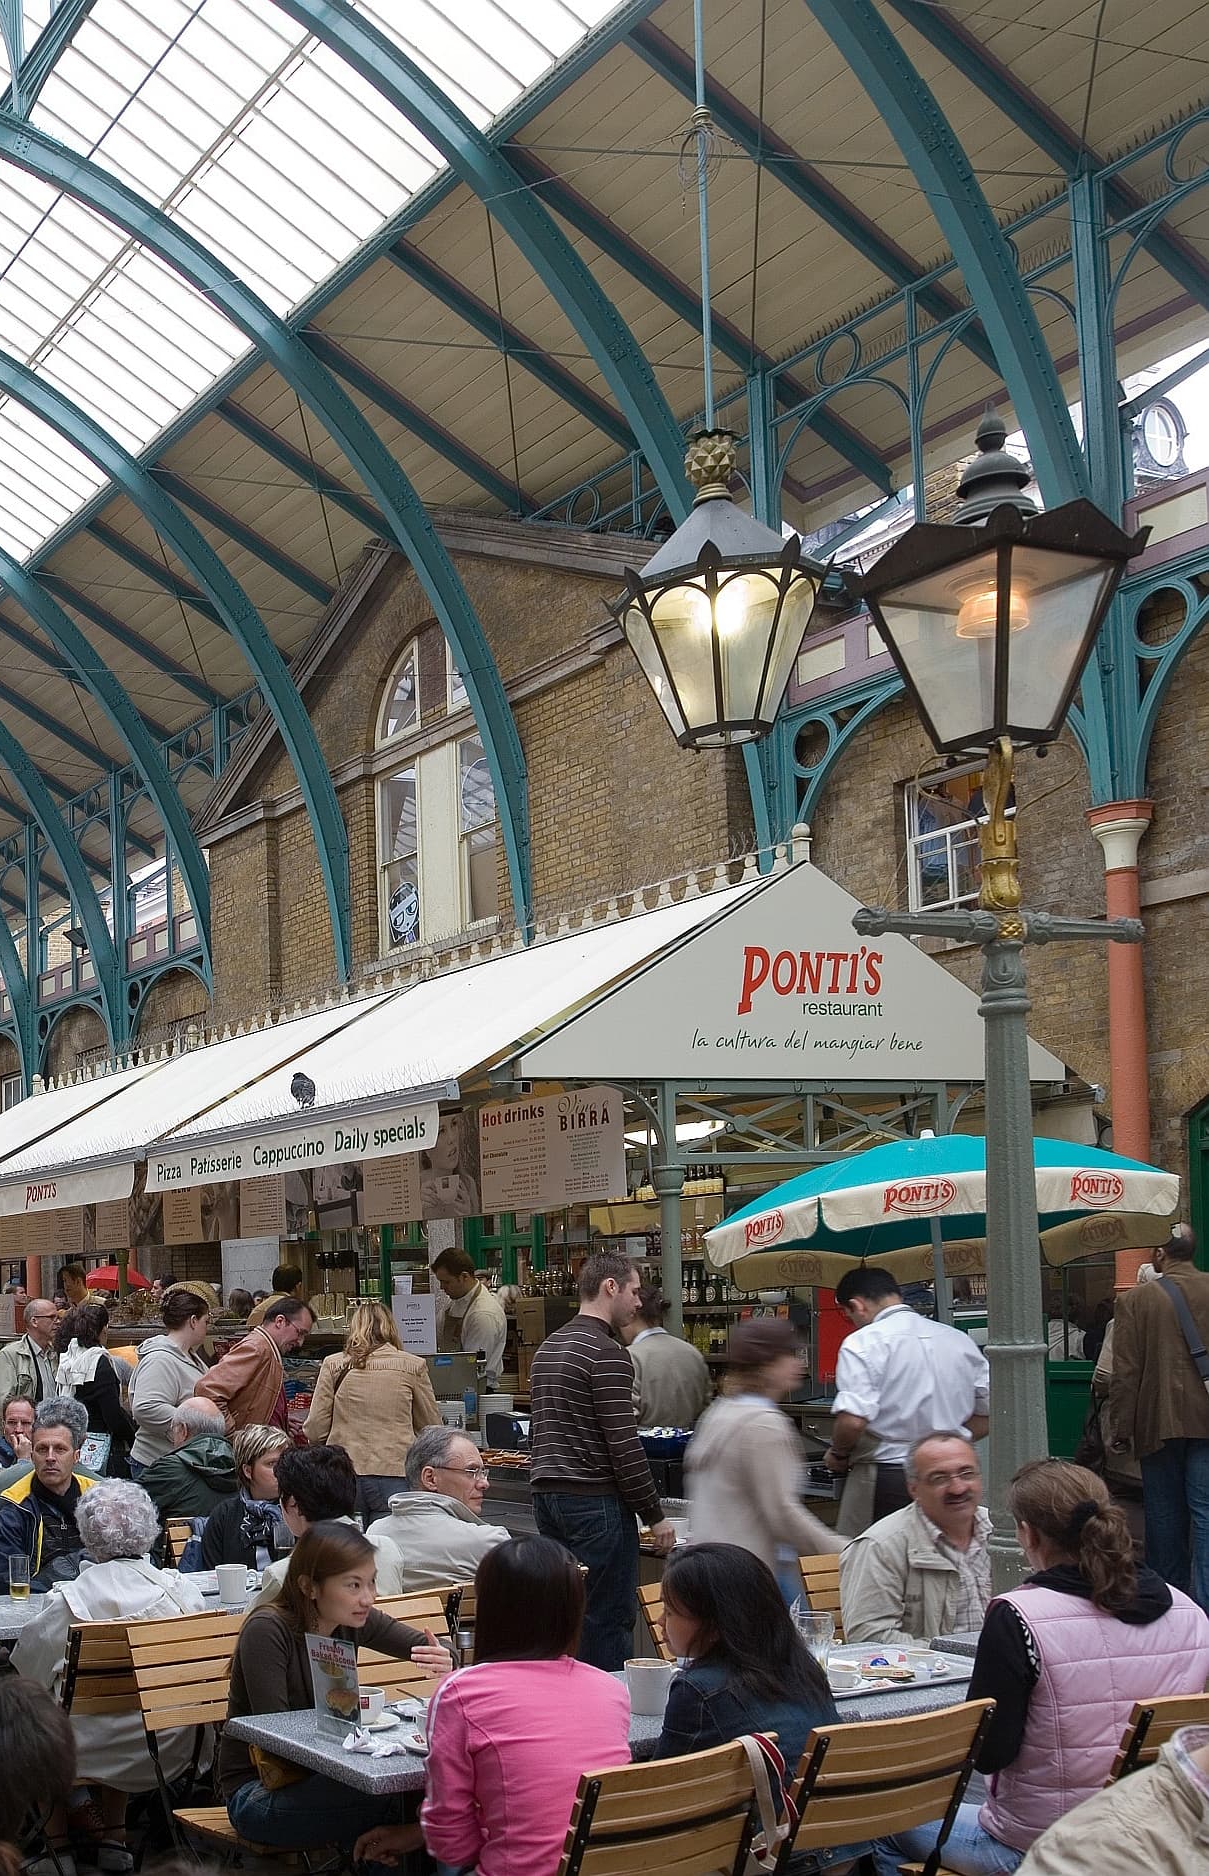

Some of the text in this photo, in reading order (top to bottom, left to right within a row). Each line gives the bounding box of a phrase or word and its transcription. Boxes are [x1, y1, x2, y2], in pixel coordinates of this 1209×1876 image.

[738, 946, 883, 1015] PONTI'S
[802, 1002, 883, 1017] restaurant
[692, 1028, 924, 1060] la cultura del mangiar bene
[482, 1105, 545, 1128] Hot drinks
[558, 1108, 610, 1132] BIRRA
[157, 1116, 425, 1183] Pizza Patisserie Cappuccino Daily specials
[883, 1182, 951, 1214] PONTI'S
[1071, 1177, 1122, 1201] PONTI'S
[745, 1212, 783, 1248] PONTI'S
[319, 1642, 344, 1656] Freshly
